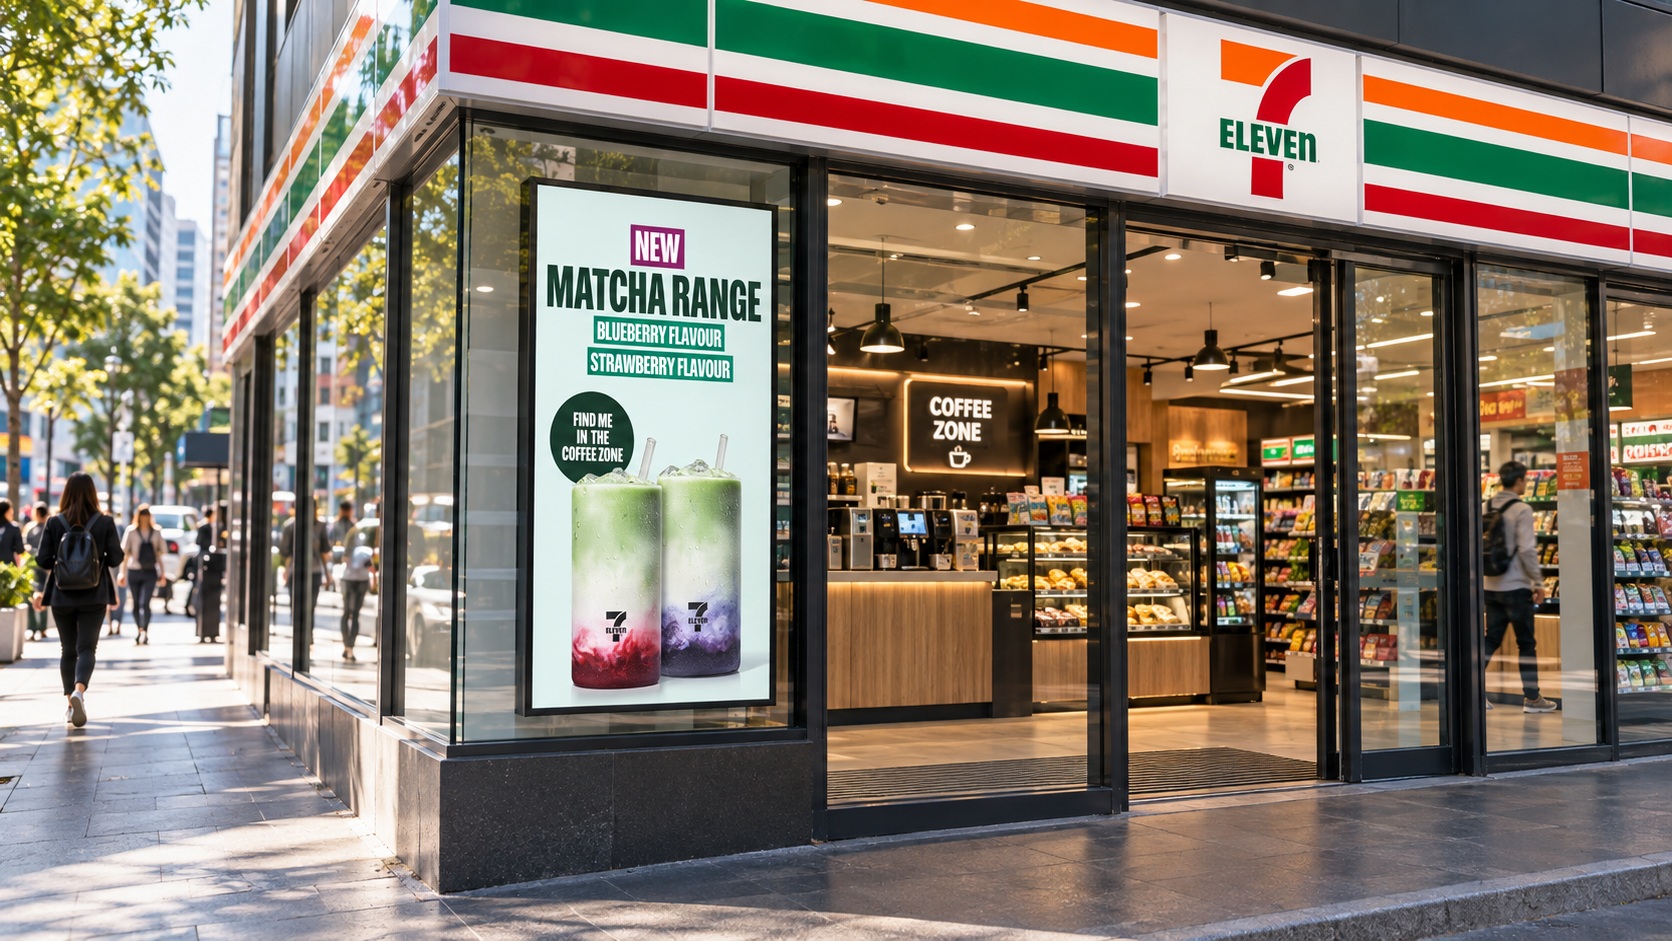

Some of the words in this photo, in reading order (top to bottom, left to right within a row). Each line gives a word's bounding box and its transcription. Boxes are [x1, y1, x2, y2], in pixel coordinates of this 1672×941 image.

[1221, 39, 1311, 199] 7
[635, 230, 680, 264] NEW
[547, 264, 666, 315] MATCHA
[672, 275, 761, 322] RANGE
[597, 321, 666, 344] BLUEBERRY
[669, 325, 722, 348] FLAVOUR
[590, 352, 676, 376] STRAWBERRY
[677, 357, 730, 379] FLAVOUR
[573, 411, 596, 427] FIND
[598, 413, 613, 428] ME
[929, 396, 992, 419] COFFEE
[576, 430, 588, 444] IN
[591, 430, 609, 445] THE
[933, 420, 981, 441] ZONE
[562, 446, 597, 462] COFFEE
[598, 447, 624, 463] ZONE
[606, 611, 626, 642] 7
[688, 602, 708, 632] 7
